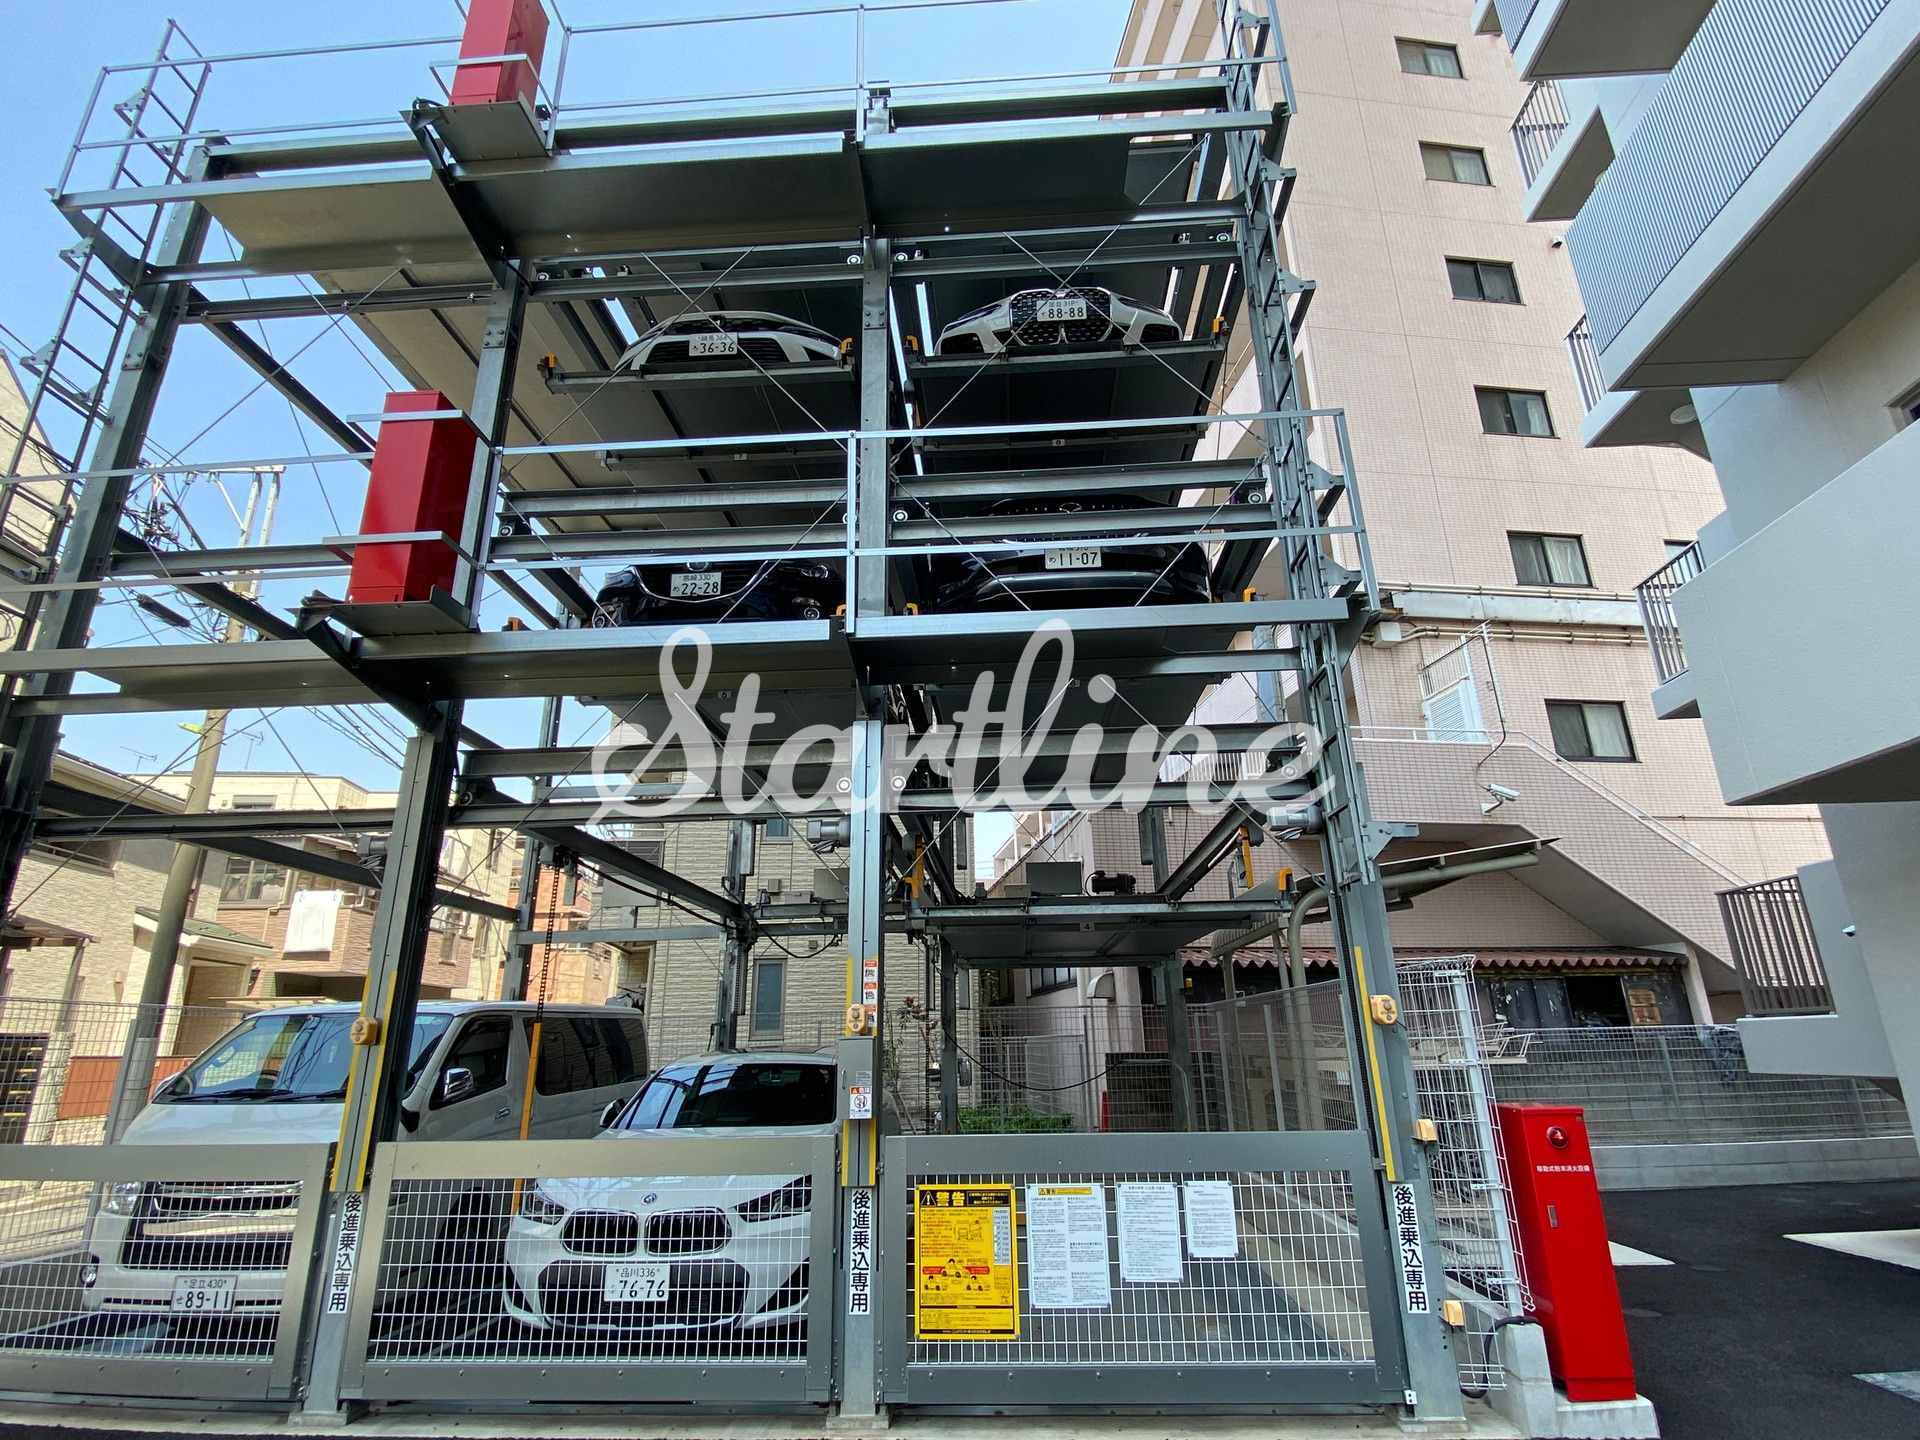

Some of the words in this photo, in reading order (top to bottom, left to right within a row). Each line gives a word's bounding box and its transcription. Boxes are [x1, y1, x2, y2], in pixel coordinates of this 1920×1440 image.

[1049, 307, 1083, 319] 88-88
[700, 341, 735, 354] 36-36
[1059, 551, 1098, 566] 11-07
[681, 581, 719, 595] 22-28
[936, 1191, 966, 1207] 警告
[328, 1193, 362, 1312] 後進乗込専用
[851, 1189, 871, 1313] 後進乗込専用
[1394, 1185, 1428, 1312] 後進乗込専用
[620, 1267, 656, 1278] 品川336
[189, 1279, 224, 1289] 足立430
[618, 1279, 666, 1299] 76-76
[185, 1290, 230, 1309] 89-11
